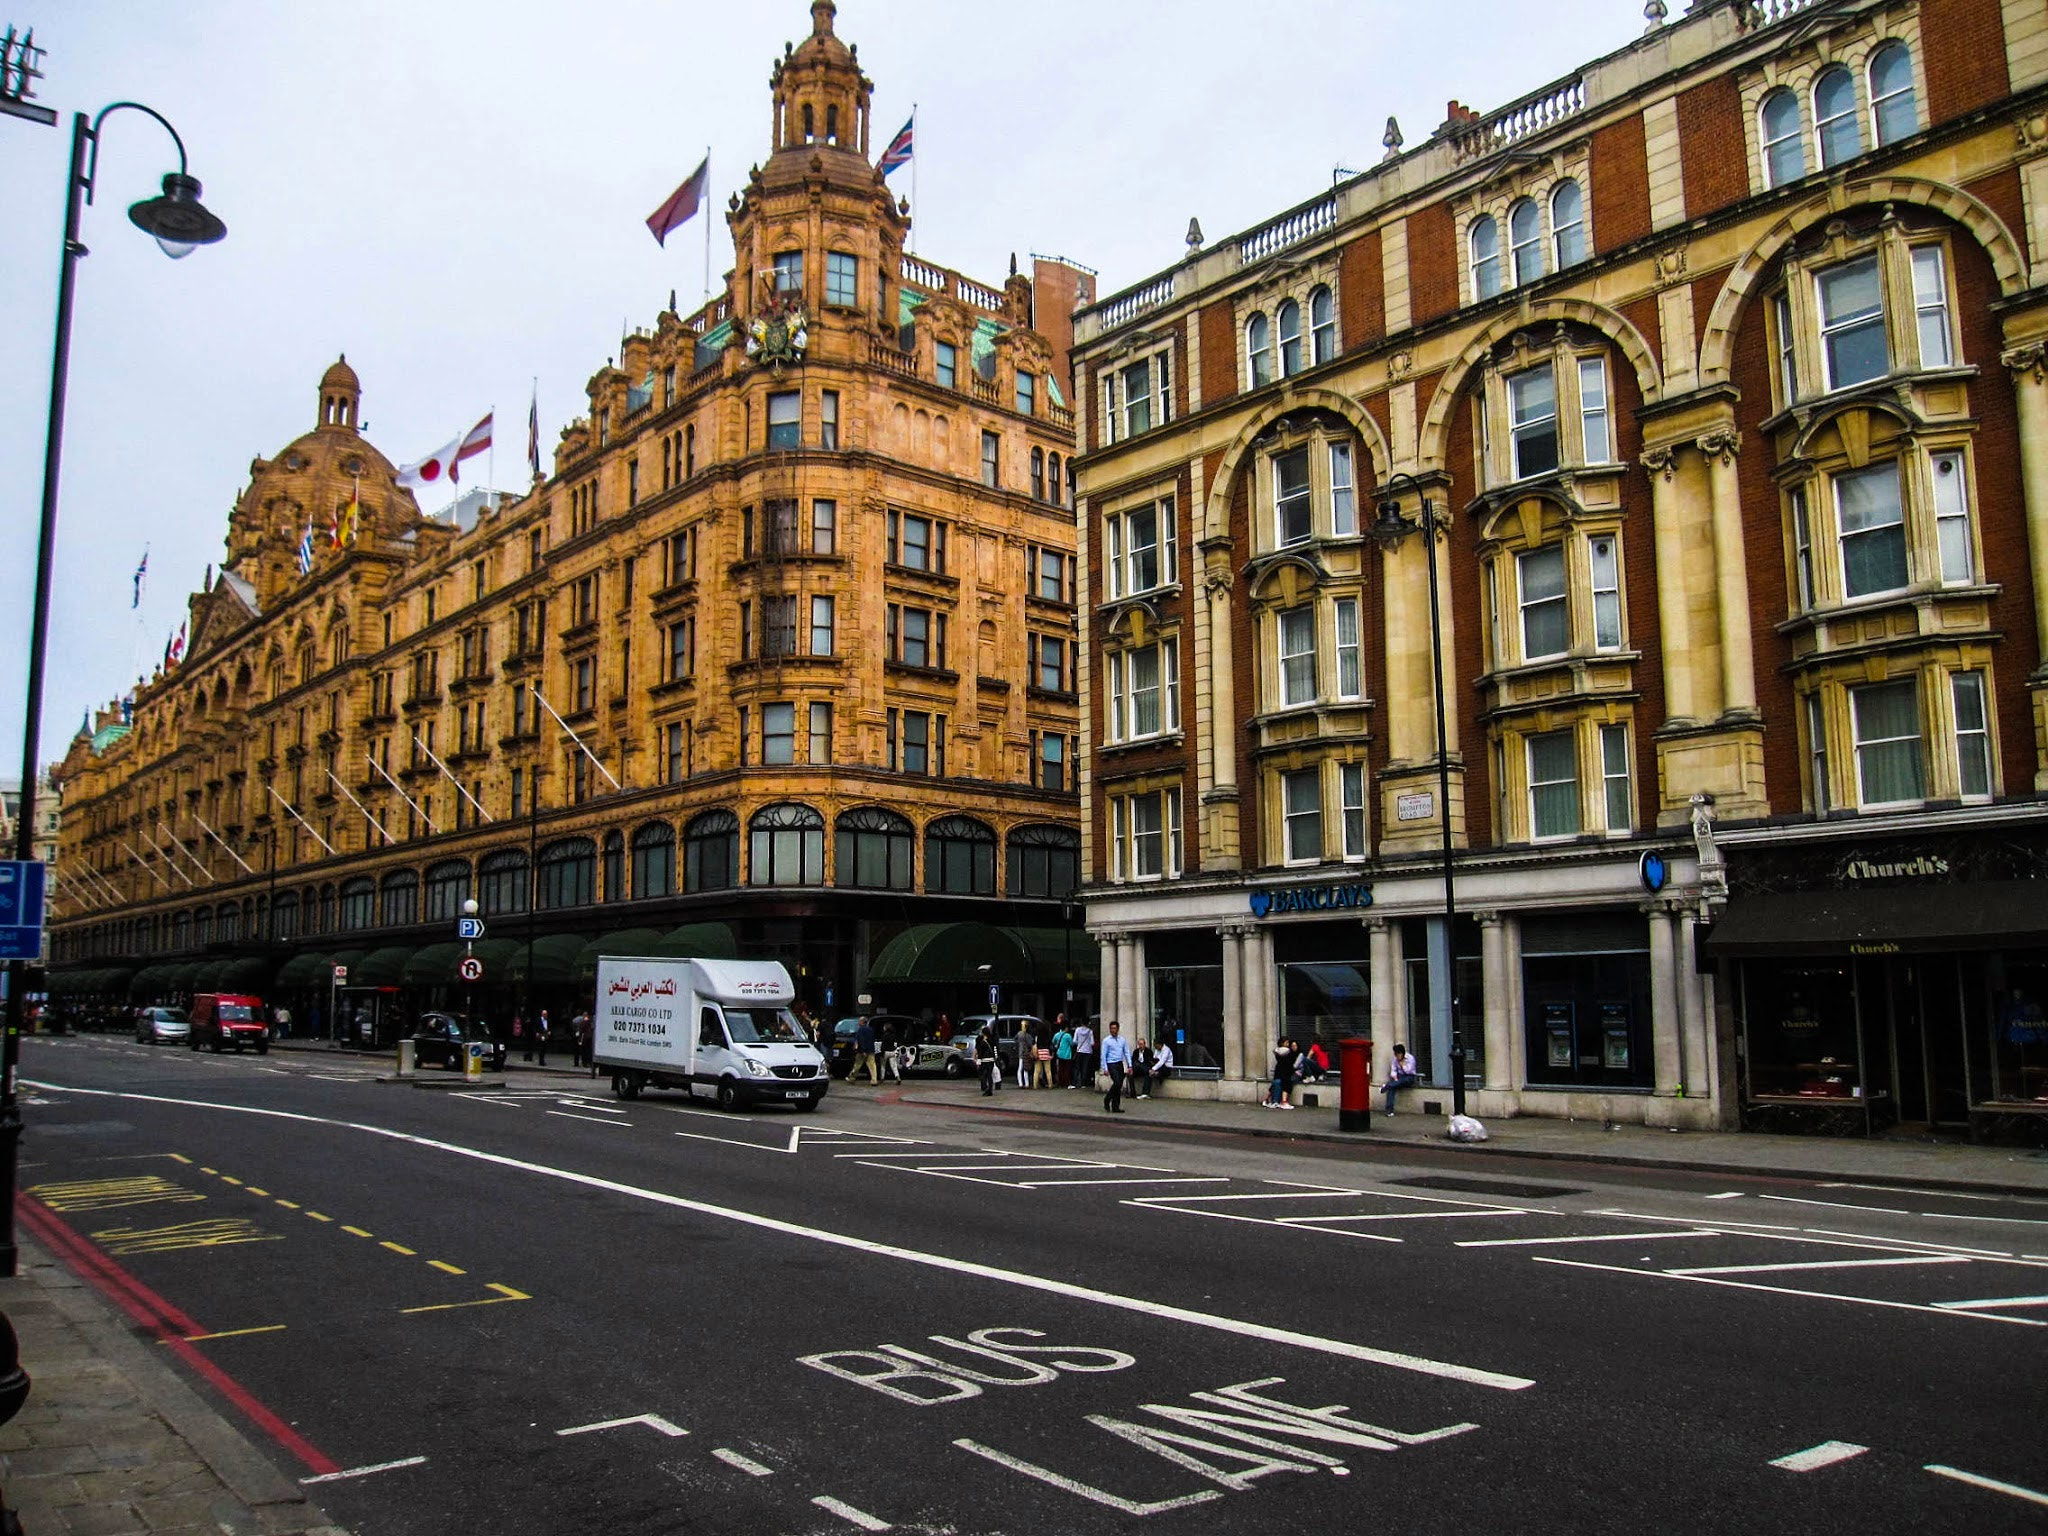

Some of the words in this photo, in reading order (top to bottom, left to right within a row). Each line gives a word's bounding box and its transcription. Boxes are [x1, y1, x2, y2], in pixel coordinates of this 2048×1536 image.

[1847, 855, 1950, 879] Church's
[1272, 884, 1374, 912] BARCLAYS
[462, 921, 472, 935] P
[1850, 943, 1899, 954] Church's
[611, 1006, 625, 1016] ARAB
[627, 1006, 646, 1017] CARGO
[648, 1008, 657, 1019] CO
[659, 1009, 672, 1020] LTD
[614, 1021, 626, 1031] 020
[628, 1022, 645, 1033] 7373
[648, 1024, 666, 1035] 1034
[923, 1052, 942, 1061] ALDO
[794, 1326, 1137, 1406] BUS
[951, 1376, 1482, 1517] LANE
